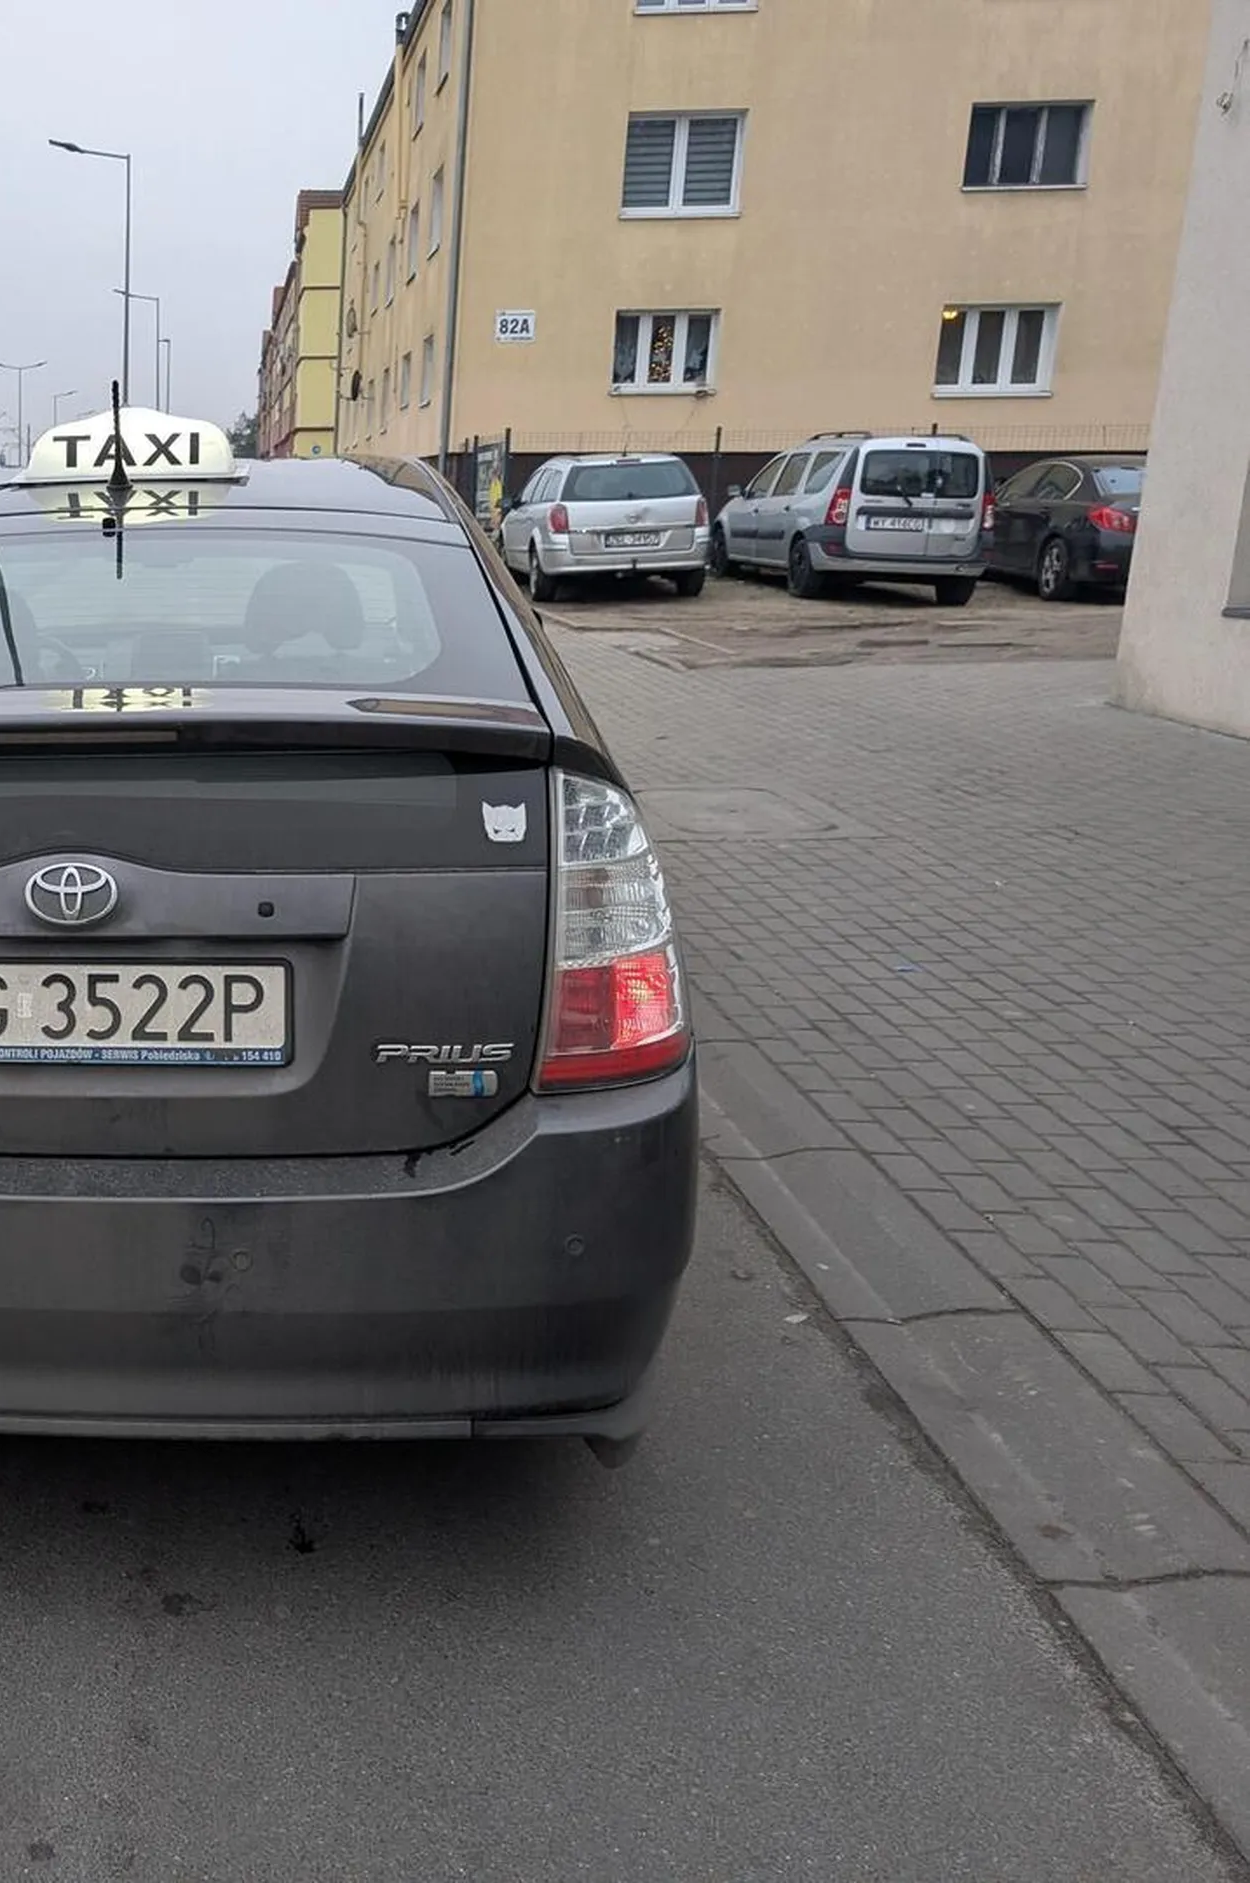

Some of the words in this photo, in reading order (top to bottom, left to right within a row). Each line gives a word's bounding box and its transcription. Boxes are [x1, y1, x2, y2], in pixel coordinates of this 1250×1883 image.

[499, 318, 530, 334] 82A
[52, 431, 201, 468] TAXI
[40, 972, 265, 1042] 3522P
[40, 1046, 93, 1060] POJAZDÓW
[101, 1048, 140, 1061] SERWIS
[241, 1050, 260, 1061] 154
[261, 1050, 282, 1061] 410
[375, 1043, 515, 1063] PRIUS
